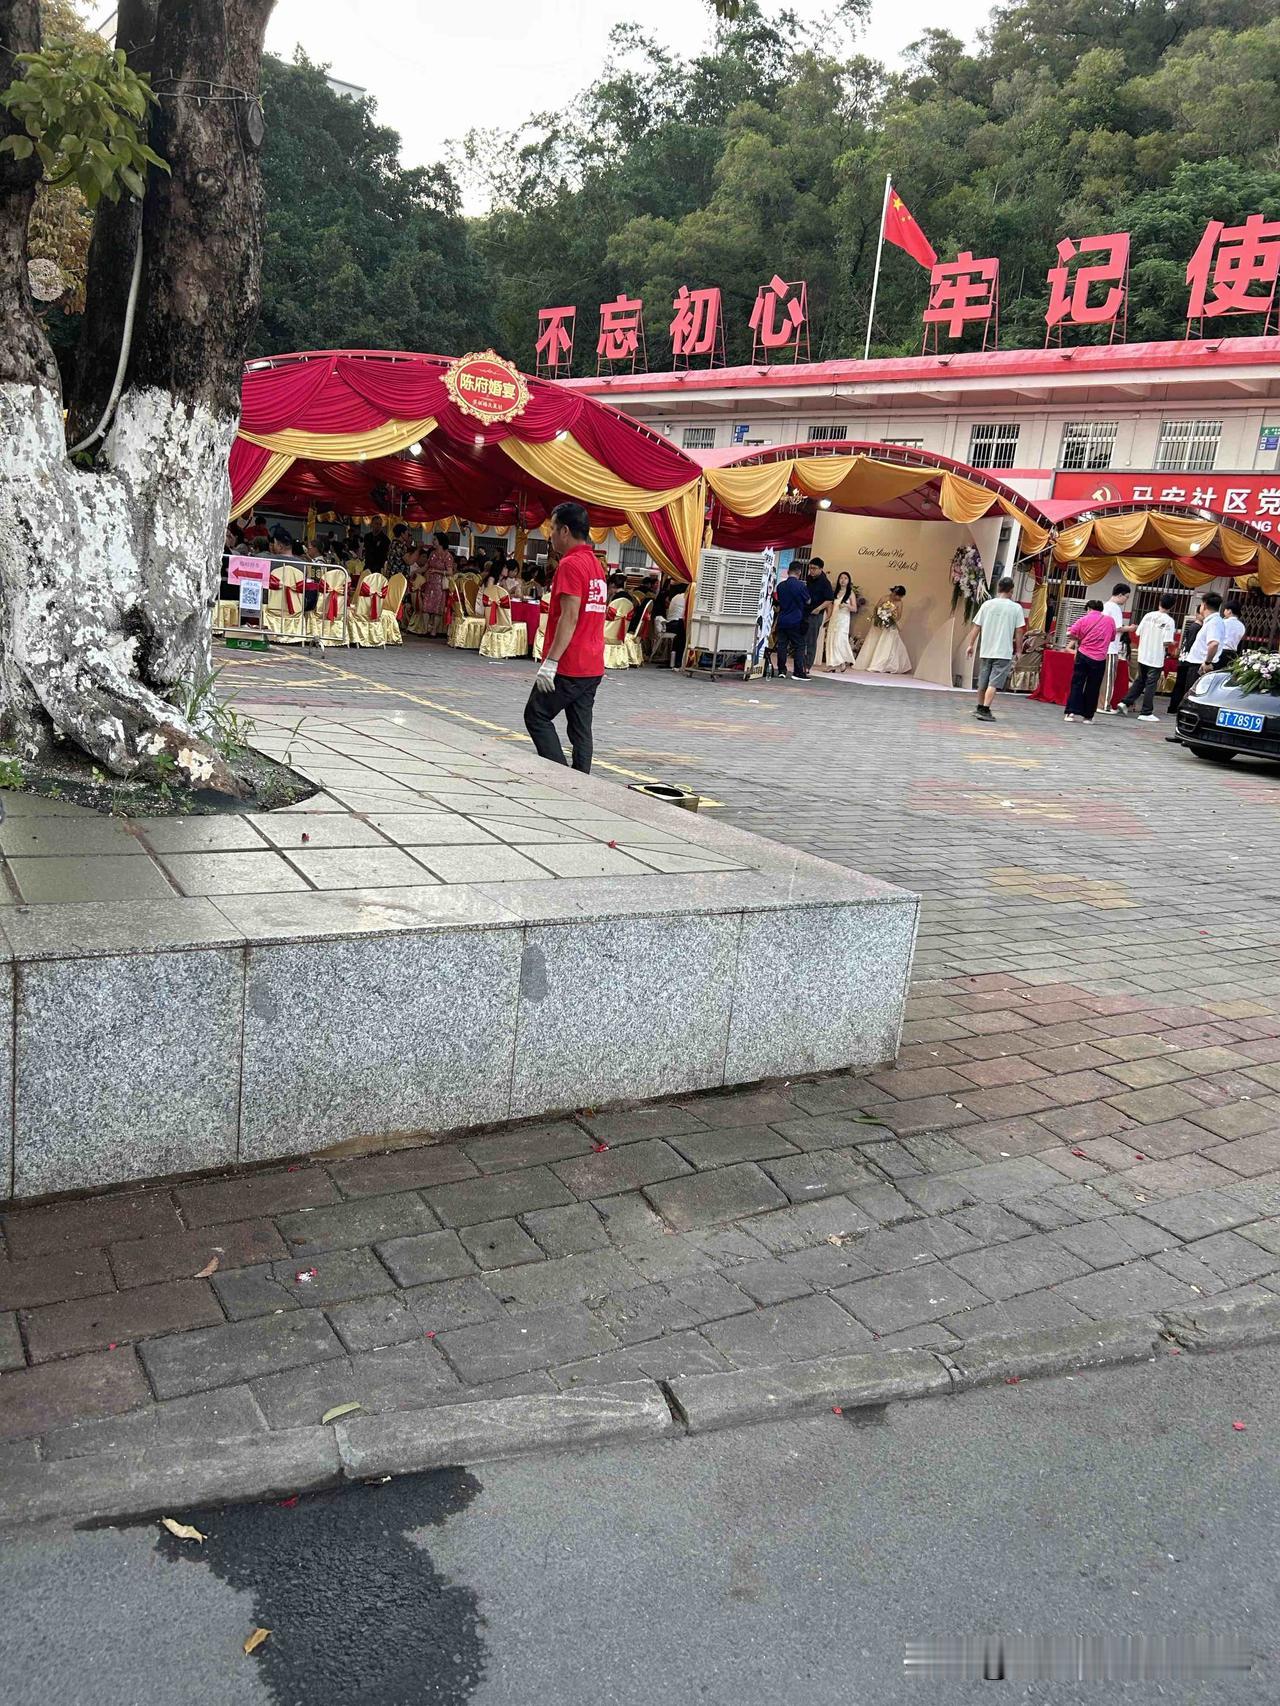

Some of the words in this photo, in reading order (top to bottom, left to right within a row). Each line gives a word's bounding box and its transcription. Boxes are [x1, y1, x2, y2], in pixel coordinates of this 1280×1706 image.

[535, 275, 804, 365] 不忘初心
[923, 214, 1280, 337] 牢记使
[460, 373, 516, 400] 陈府婚宴
[1245, 519, 1272, 532] NG
